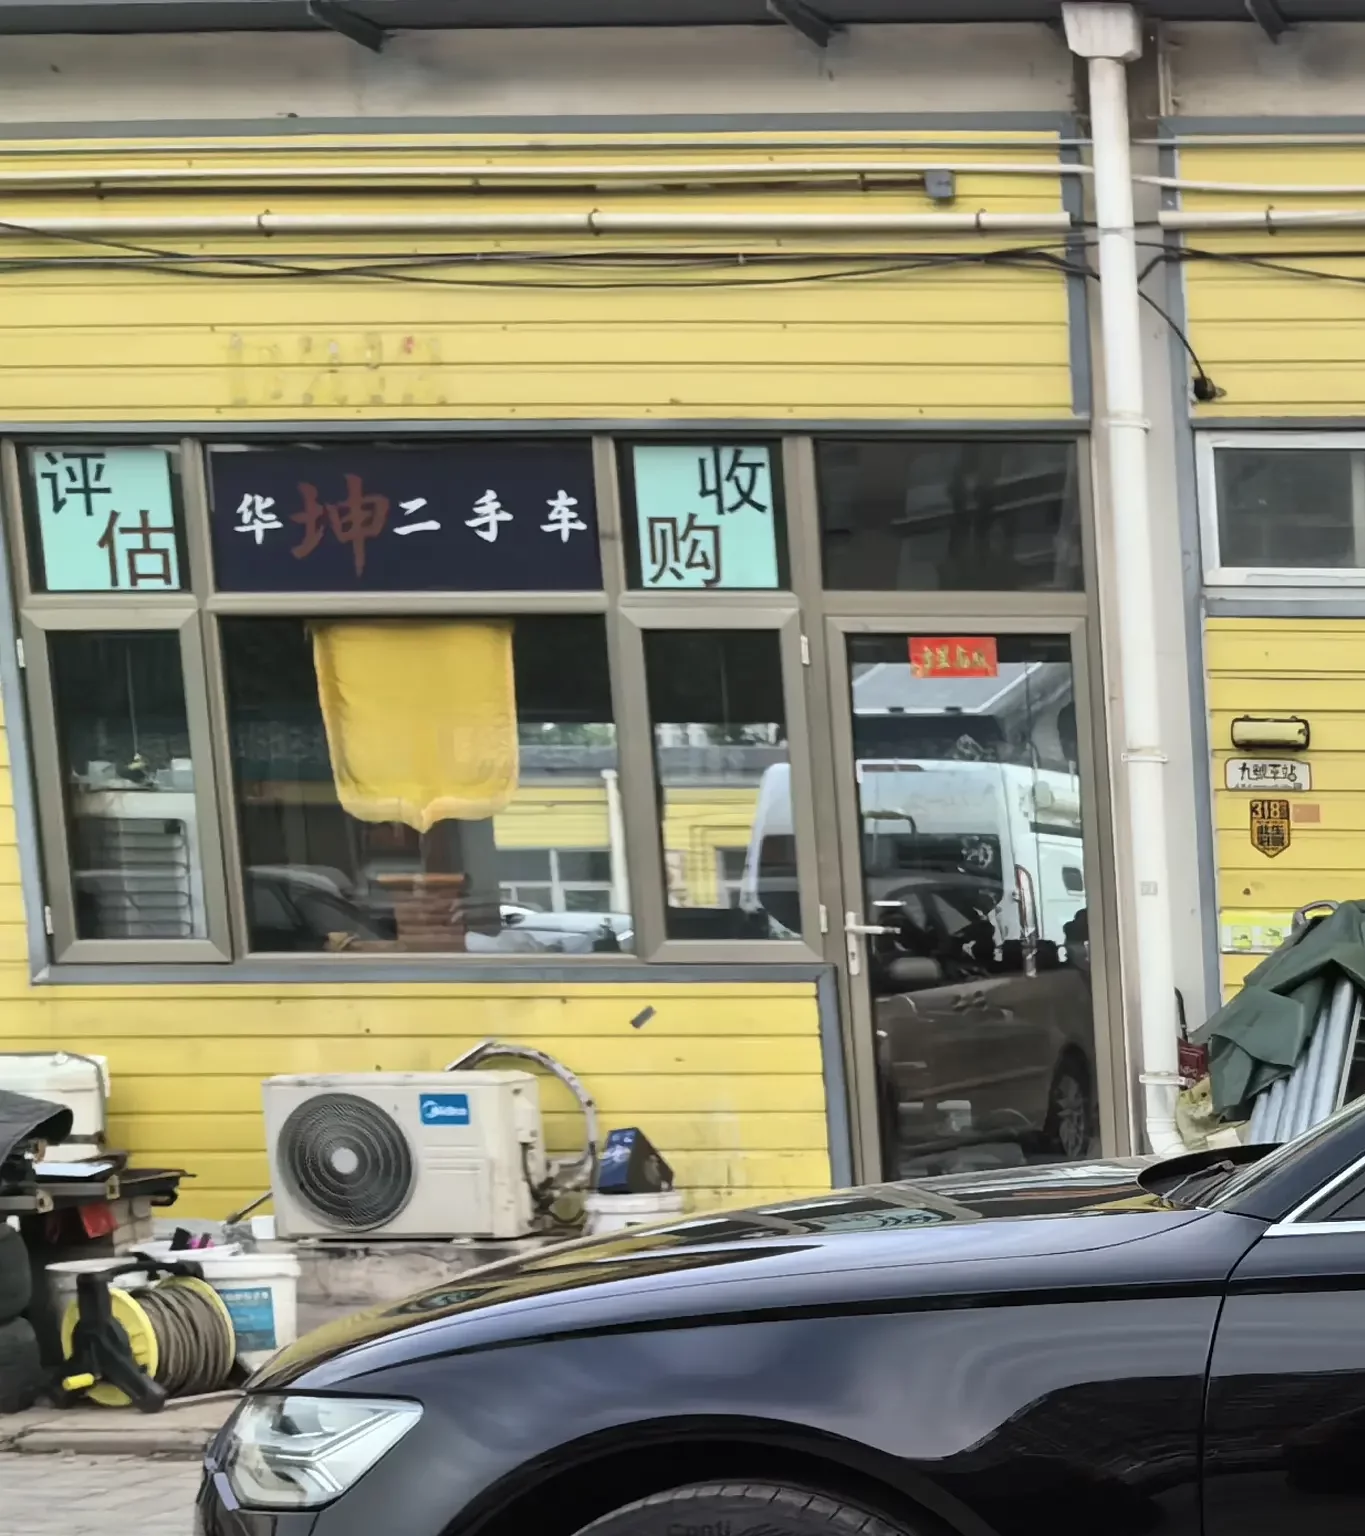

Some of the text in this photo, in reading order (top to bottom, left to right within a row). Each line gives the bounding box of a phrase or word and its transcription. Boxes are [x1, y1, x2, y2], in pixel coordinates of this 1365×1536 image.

[41, 452, 174, 587] 评估
[234, 474, 588, 577] 华坤二手车
[647, 447, 767, 587] 收购
